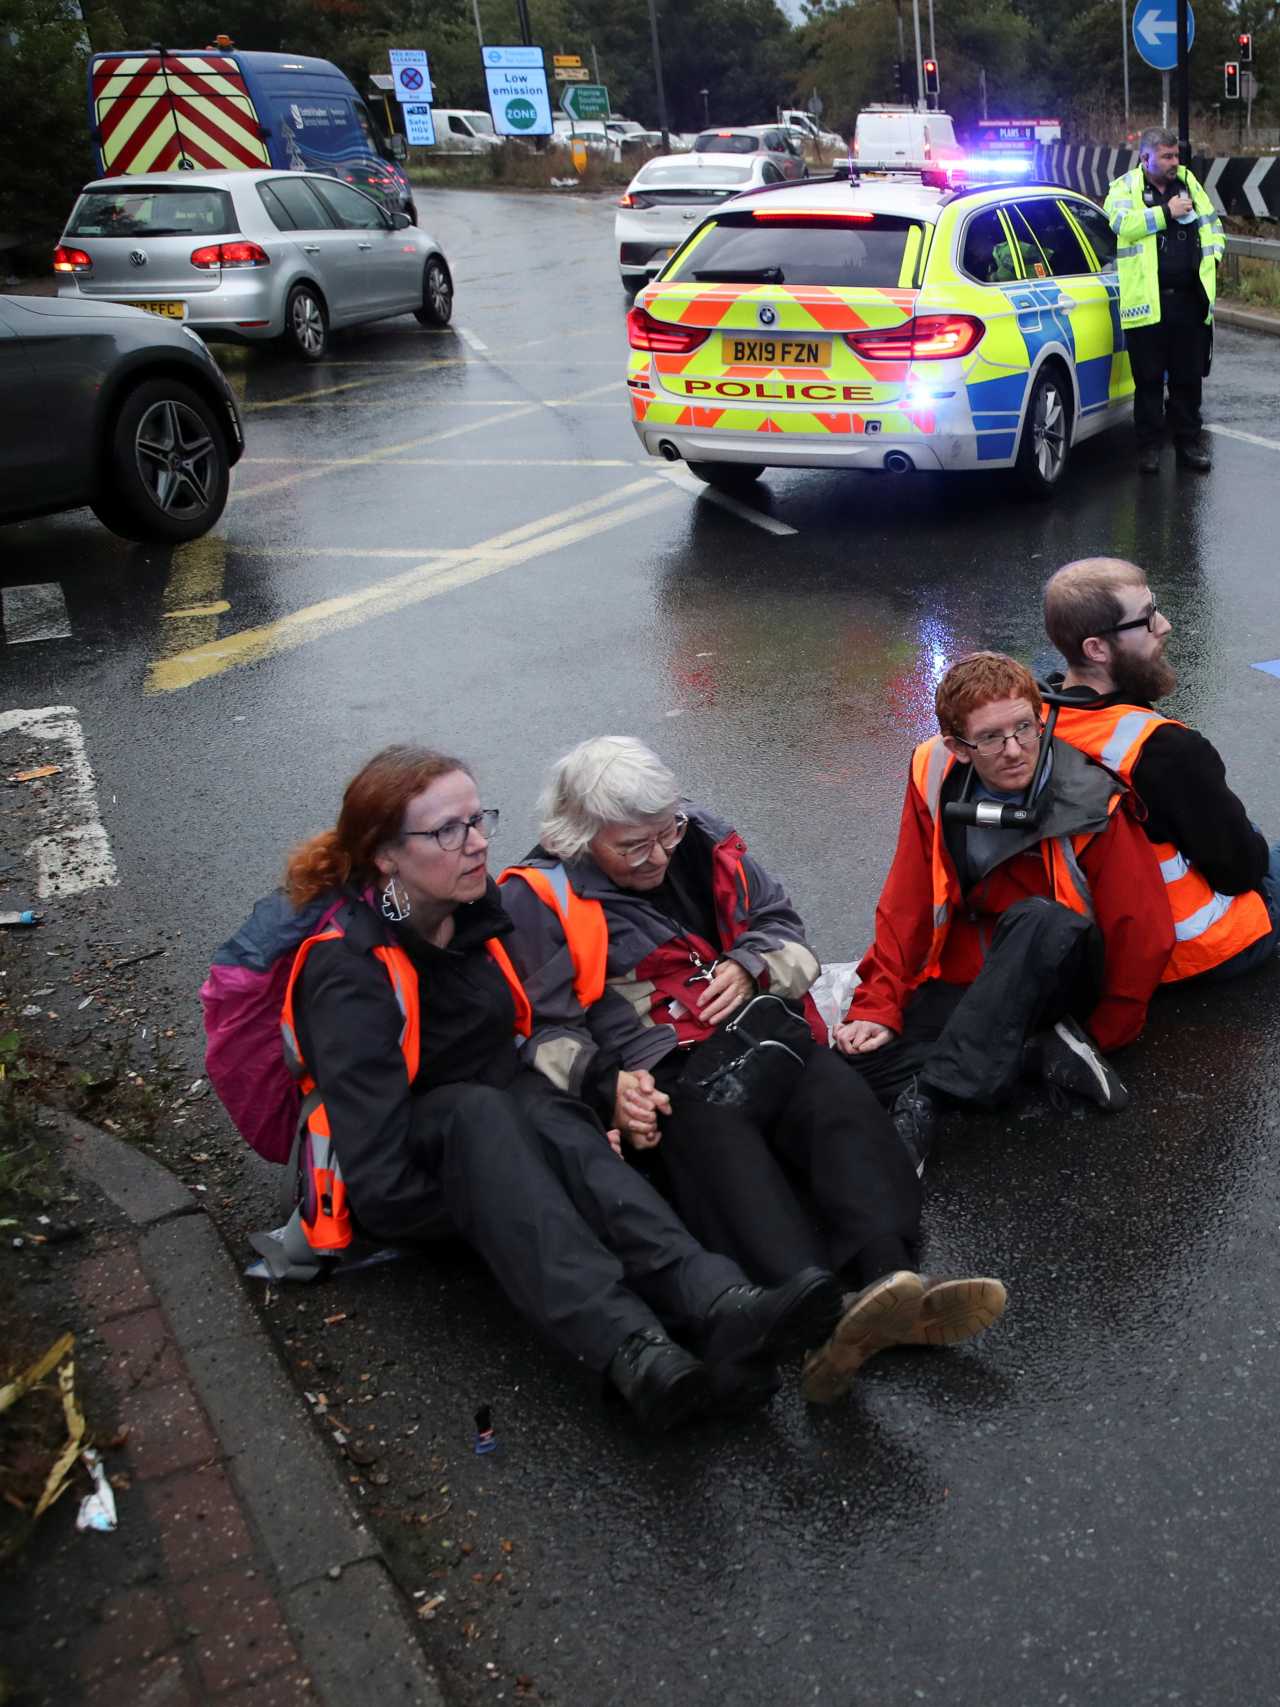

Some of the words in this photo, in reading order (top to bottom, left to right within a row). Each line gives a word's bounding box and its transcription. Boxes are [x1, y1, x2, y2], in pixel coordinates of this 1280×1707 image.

[504, 73, 528, 83] Low
[492, 84, 543, 96] emission
[506, 108, 537, 119] ZONE
[733, 341, 775, 362] BX19
[781, 342, 819, 363] FZN
[684, 380, 874, 401] POLICE
